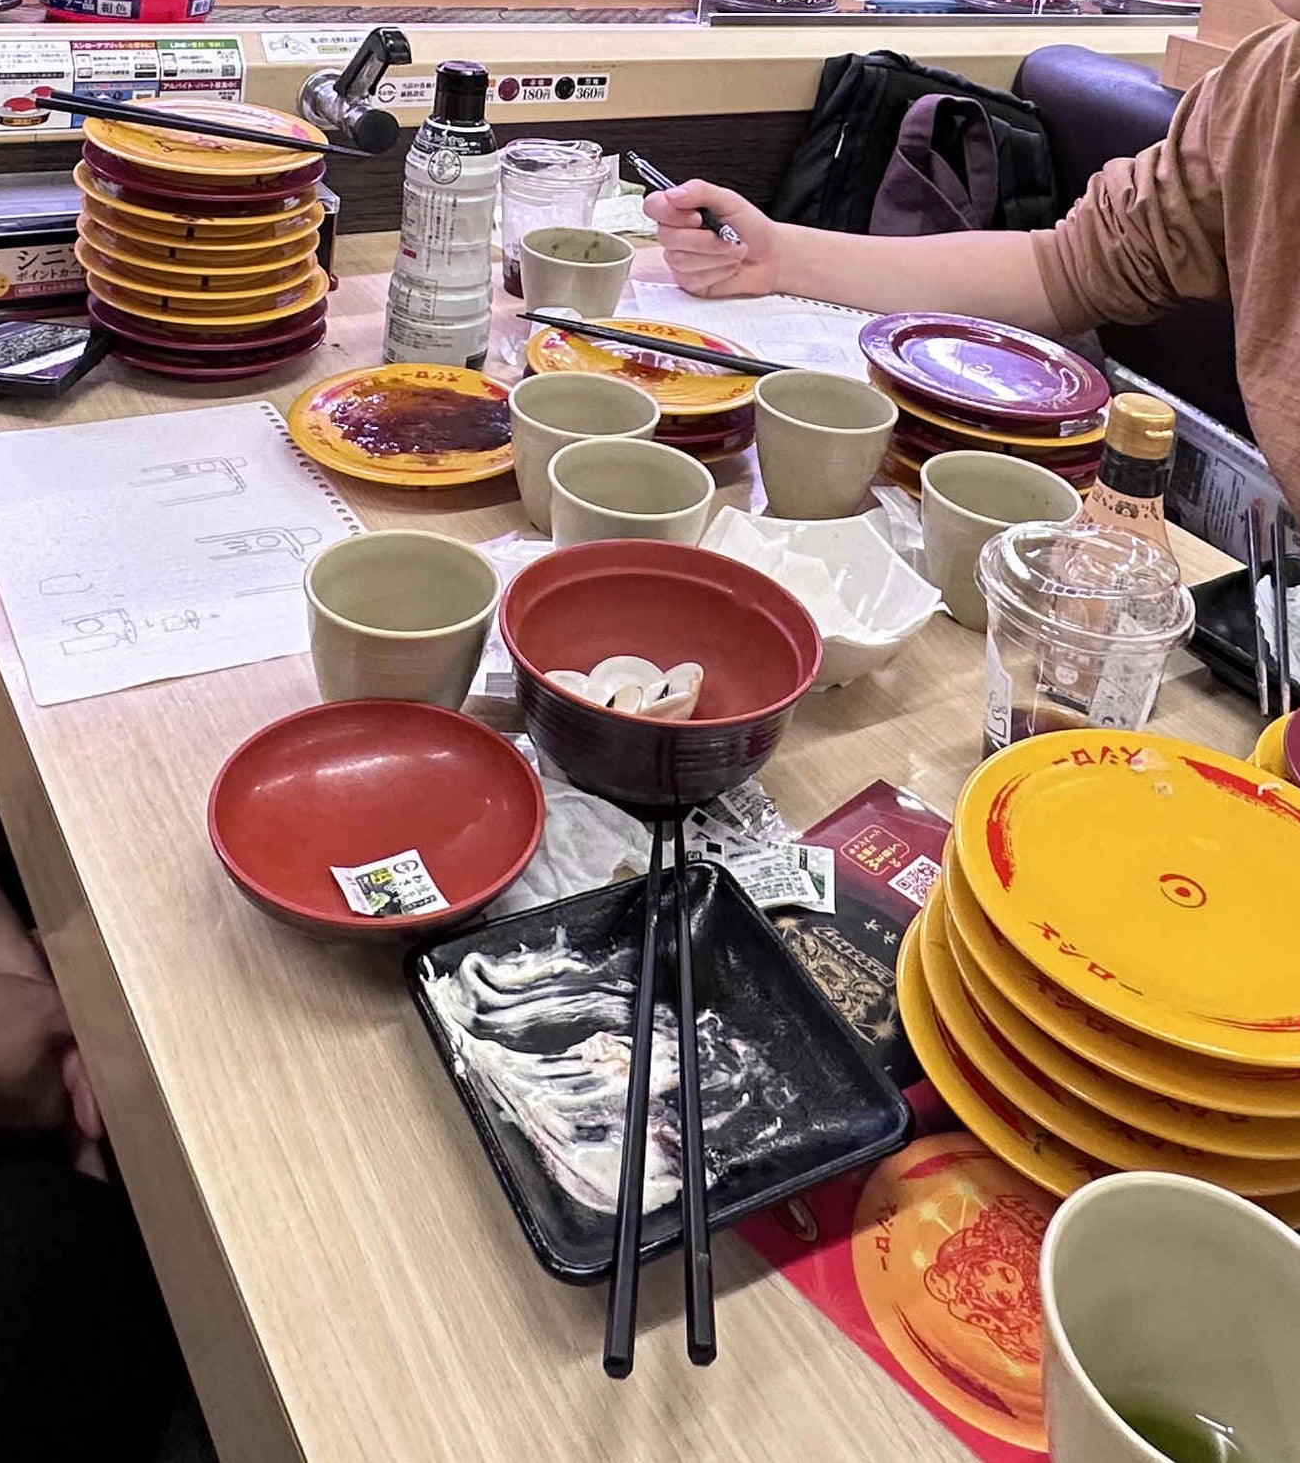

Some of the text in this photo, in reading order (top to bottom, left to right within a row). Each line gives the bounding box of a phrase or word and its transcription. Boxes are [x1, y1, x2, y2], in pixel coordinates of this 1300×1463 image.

[521, 87, 551, 101] 180円
[575, 86, 605, 100] 360円
[1051, 744, 1144, 767] スシロー
[1029, 920, 1144, 997] スシロー
